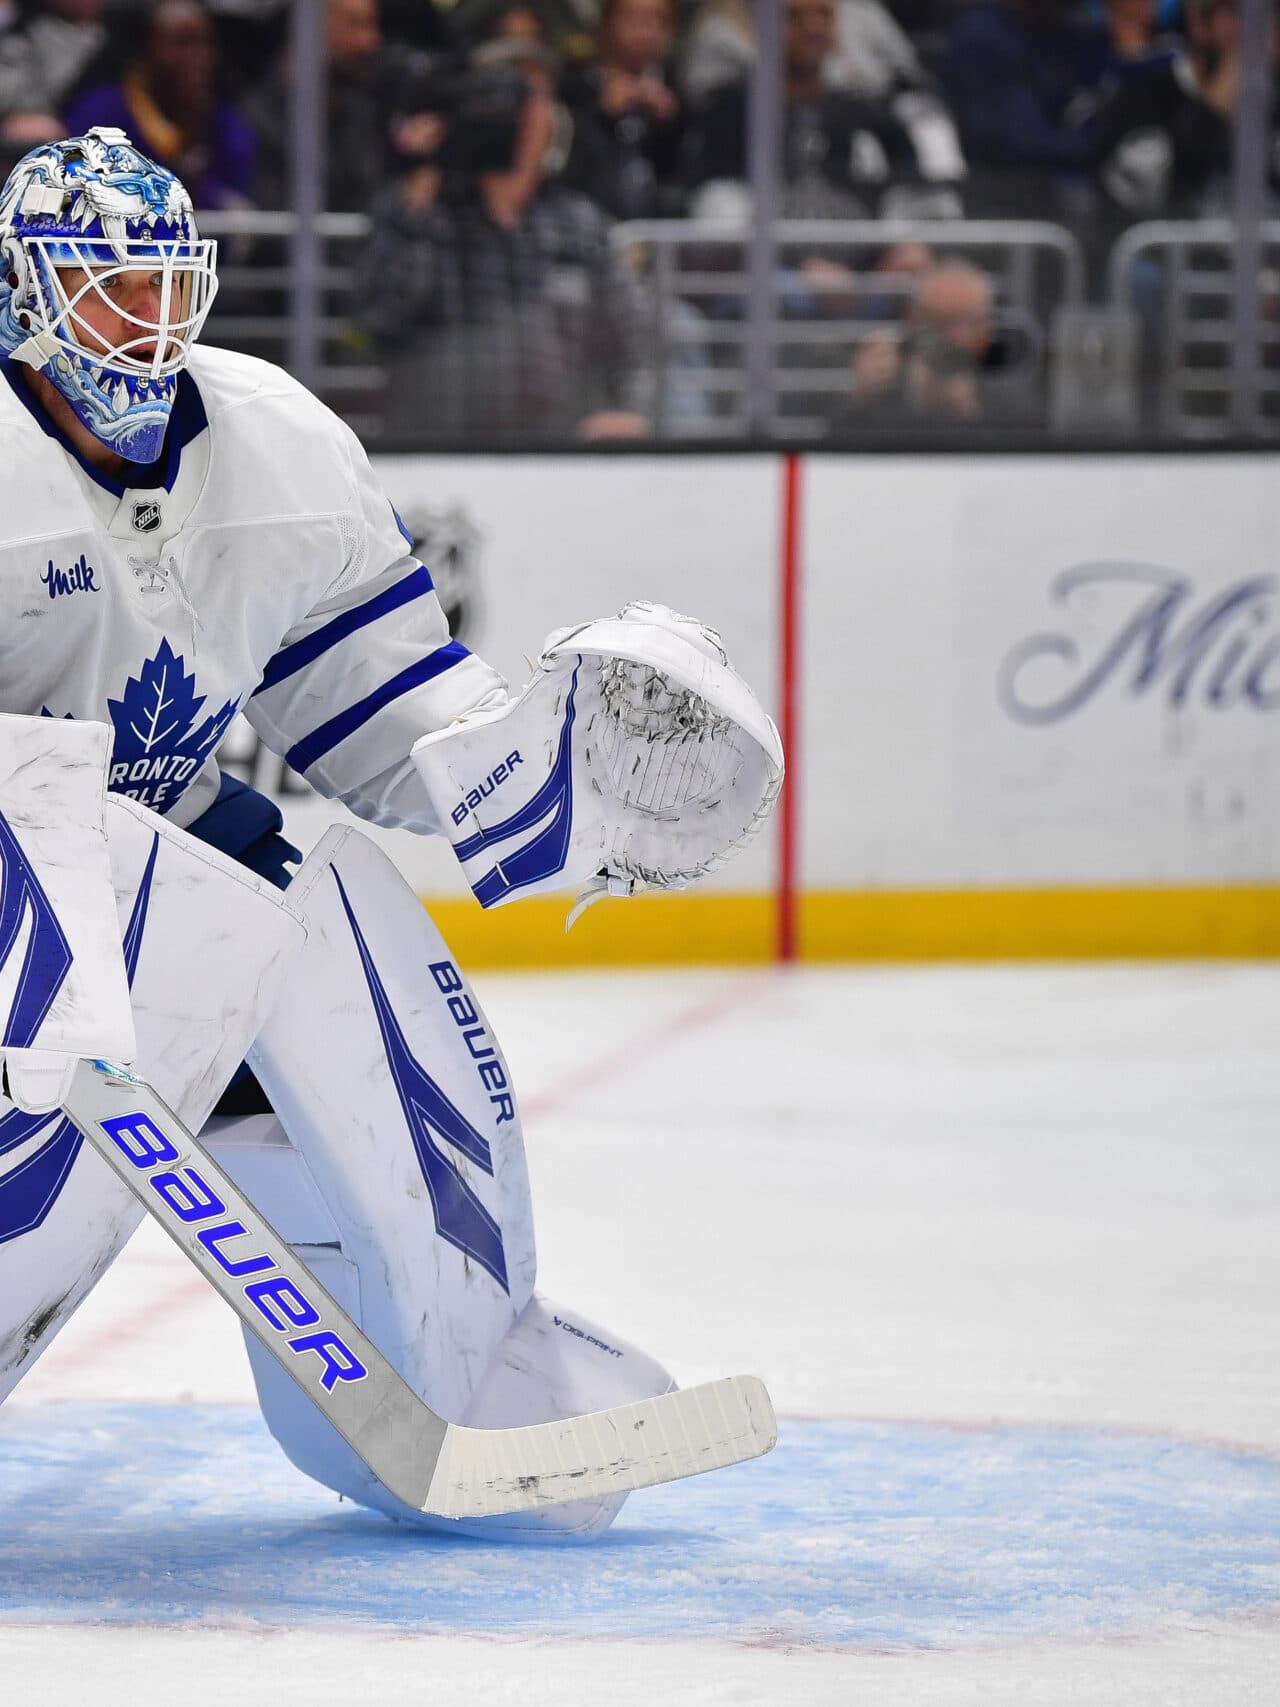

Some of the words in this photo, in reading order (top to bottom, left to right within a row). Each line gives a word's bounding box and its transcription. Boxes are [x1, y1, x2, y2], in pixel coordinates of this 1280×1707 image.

[137, 508, 158, 529] NHL
[109, 755, 197, 786] RONTO
[449, 750, 524, 827] BAUER
[427, 960, 515, 1126] BAUER
[95, 1111, 369, 1396] BAUER
